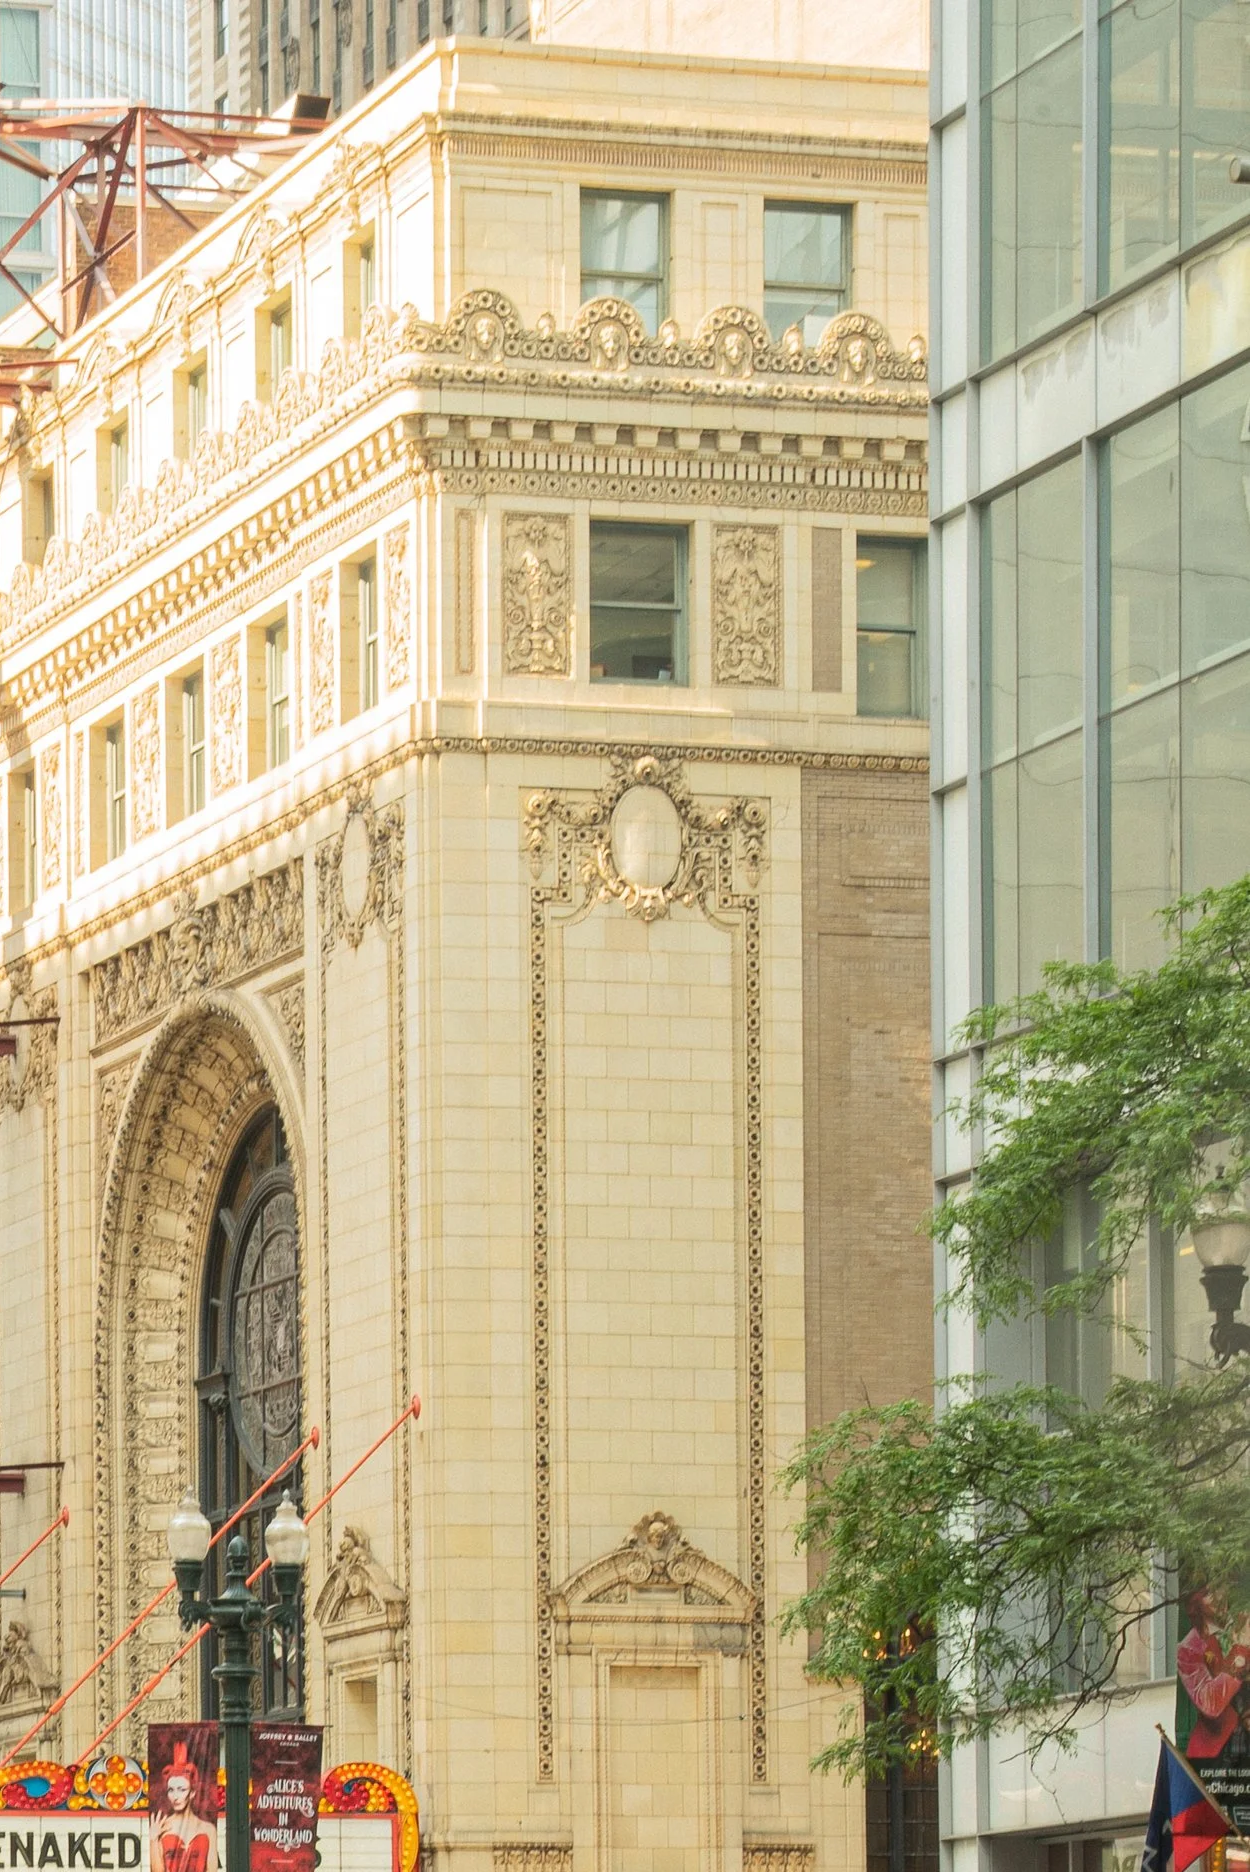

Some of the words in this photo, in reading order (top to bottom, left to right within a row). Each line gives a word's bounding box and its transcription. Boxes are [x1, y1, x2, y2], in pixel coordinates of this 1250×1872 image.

[258, 1733, 286, 1741] JOFFREY
[294, 1733, 317, 1742] BALLET
[1200, 1769, 1227, 1777] EXPLORE
[267, 1779, 304, 1794] ALICE'S
[257, 1796, 315, 1815] ADVENTURES
[278, 1812, 288, 1826] IN
[253, 1828, 313, 1846] WONDERLAND
